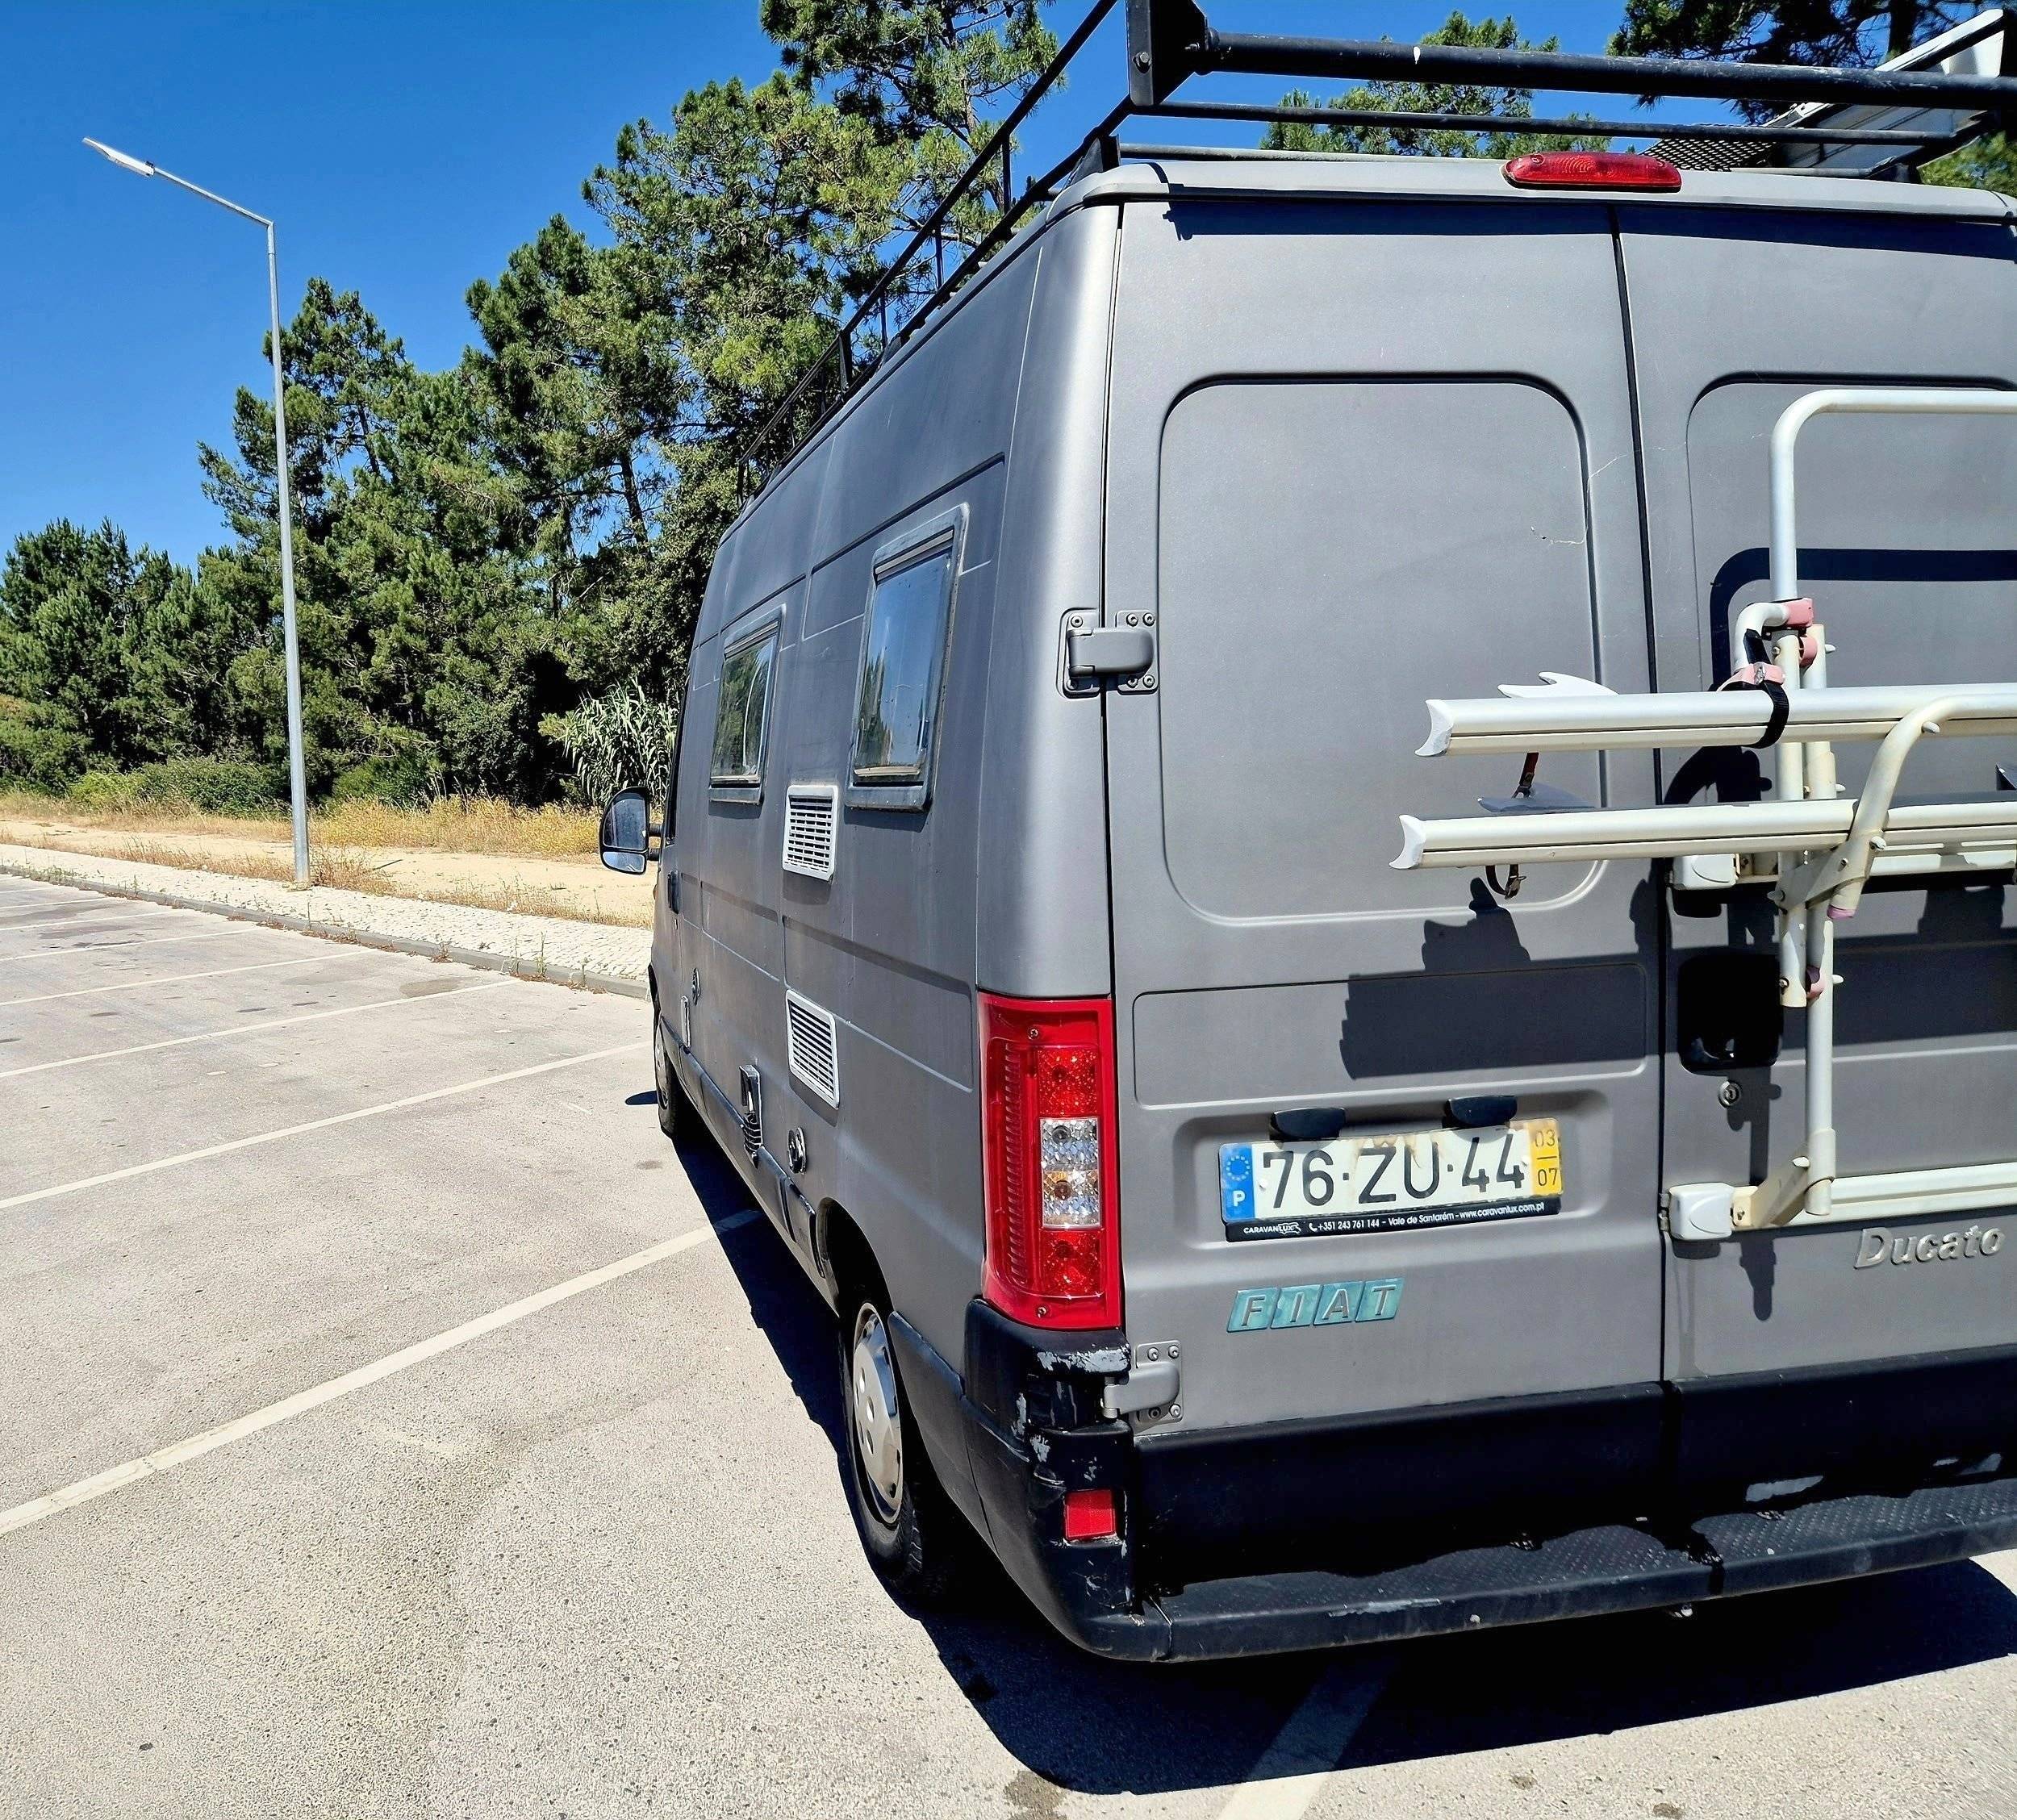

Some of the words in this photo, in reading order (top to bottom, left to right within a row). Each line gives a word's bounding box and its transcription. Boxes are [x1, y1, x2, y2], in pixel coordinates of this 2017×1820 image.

[1535, 1129, 1556, 1147] 03
[1537, 1167, 1558, 1186] 07
[1233, 1190, 1246, 1207] P
[1318, 1223, 1336, 1232] +351
[1337, 1221, 1351, 1230] 243
[1351, 1220, 1365, 1229] 761
[1367, 1218, 1380, 1228] 144
[1388, 1217, 1405, 1225] Vale
[1406, 1216, 1418, 1225] de
[1418, 1212, 1455, 1224] Santarém
[1460, 1202, 1545, 1219] www.caravanlux.com.pt
[1853, 1225, 2007, 1270] Ducato
[1239, 1284, 1397, 1327] FIAT
